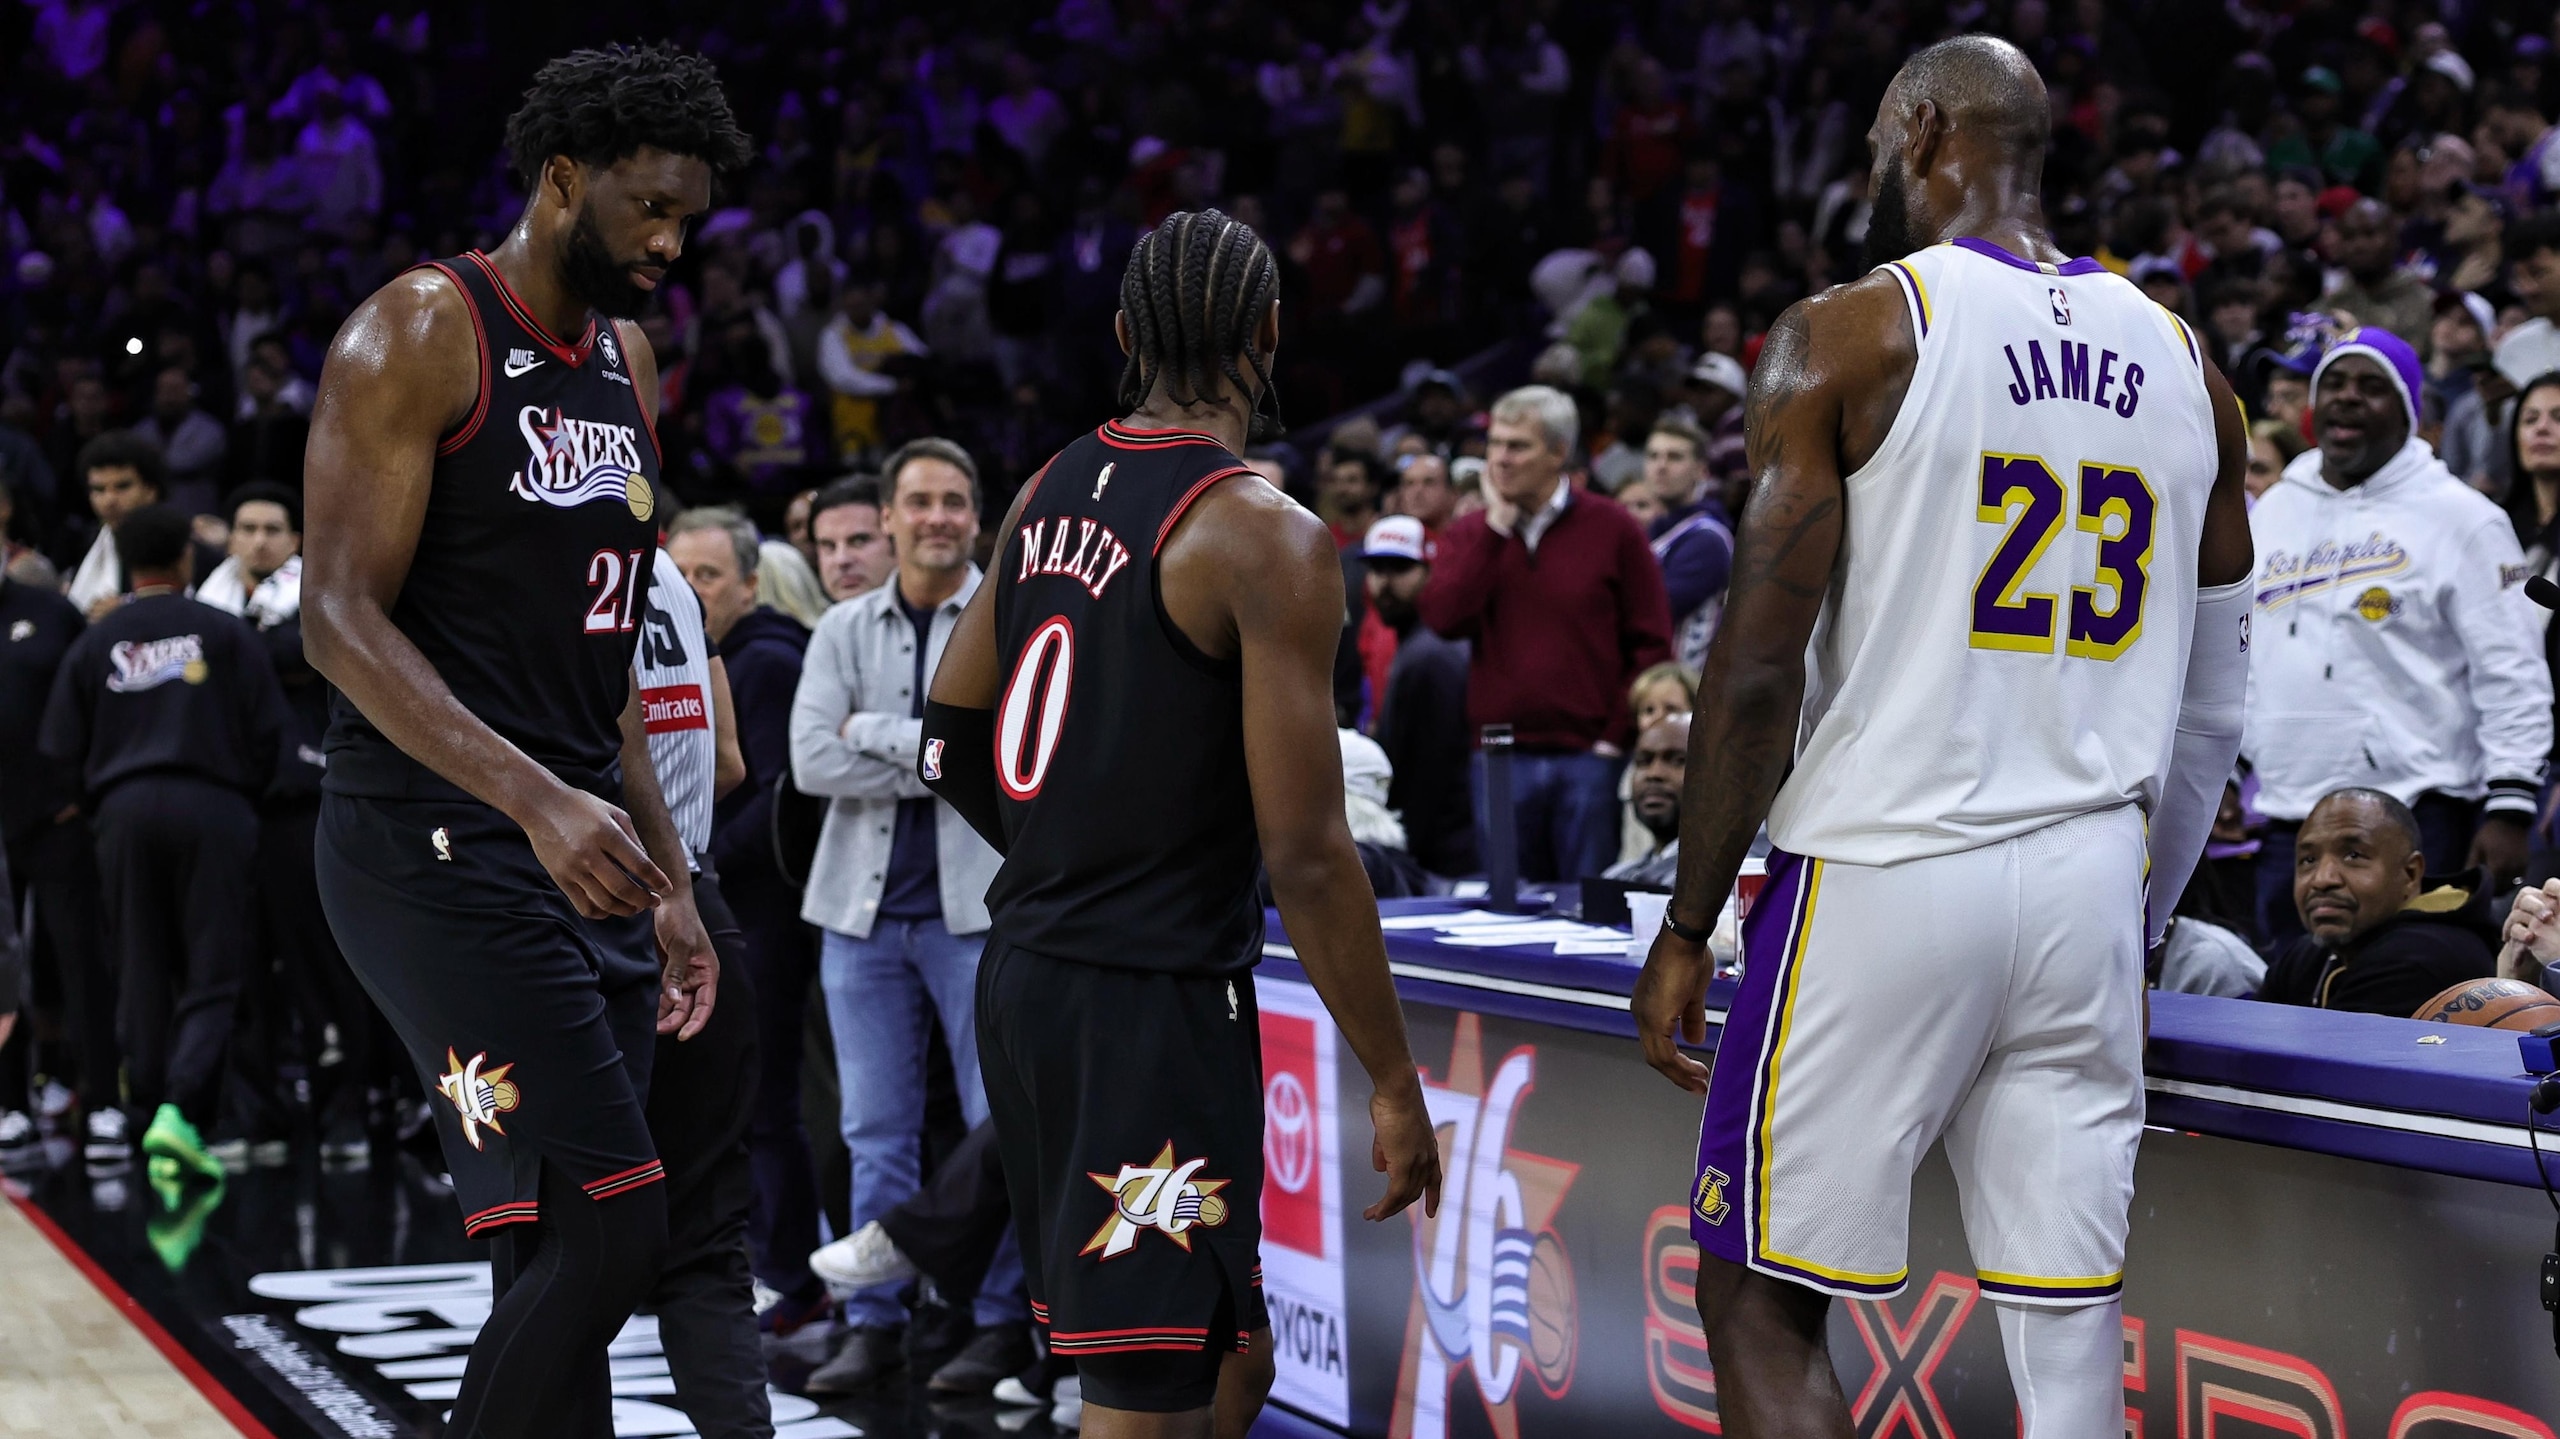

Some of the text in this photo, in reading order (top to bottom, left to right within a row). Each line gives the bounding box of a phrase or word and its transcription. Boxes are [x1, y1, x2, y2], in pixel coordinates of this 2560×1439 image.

[509, 347, 536, 366] NIKE
[2003, 338, 2145, 419] JAMES
[584, 548, 645, 634] 21
[1017, 516, 1131, 599] MAXEY
[1969, 450, 2158, 661] 23
[642, 697, 703, 722] Emirates
[993, 614, 1075, 801] 0
[1100, 1157, 1209, 1262] 76
[1265, 1292, 1344, 1378] OYOTA
